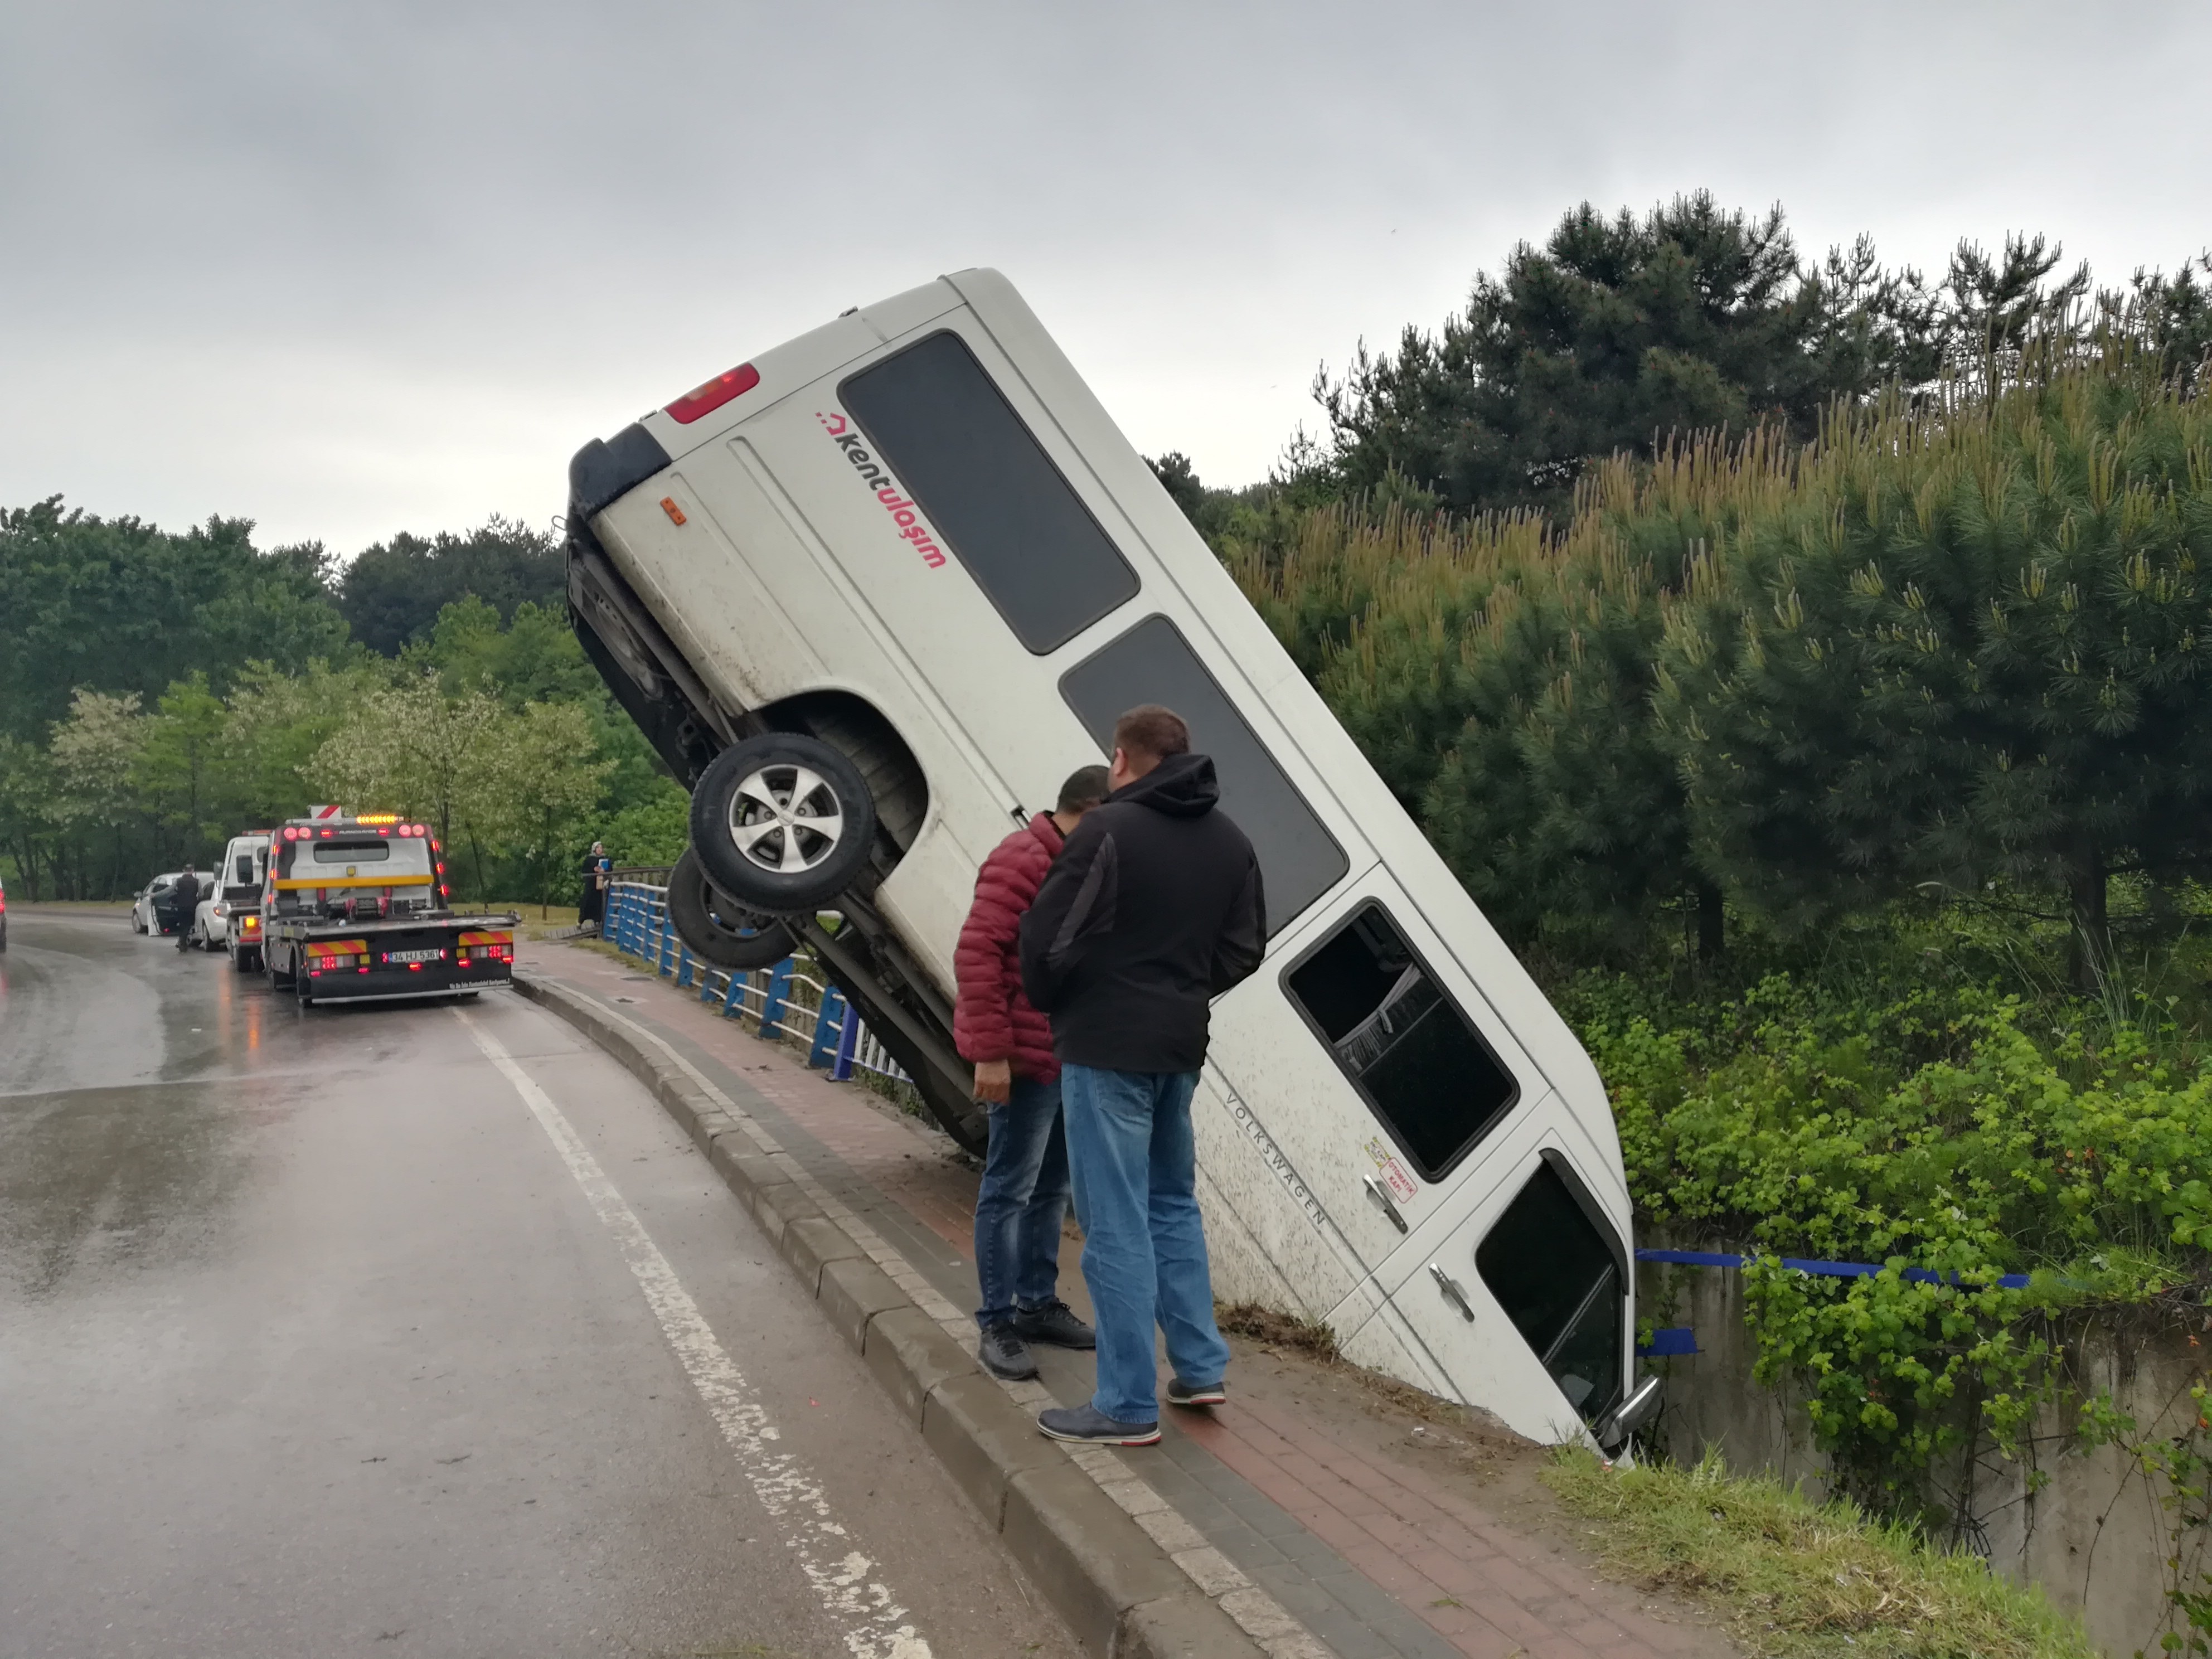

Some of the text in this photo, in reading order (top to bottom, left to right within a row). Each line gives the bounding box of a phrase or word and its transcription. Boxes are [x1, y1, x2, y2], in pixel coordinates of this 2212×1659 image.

[394, 950, 438, 961] 34 HJ 5361
[1226, 1093, 1325, 1225] VOLKSWAGEN
